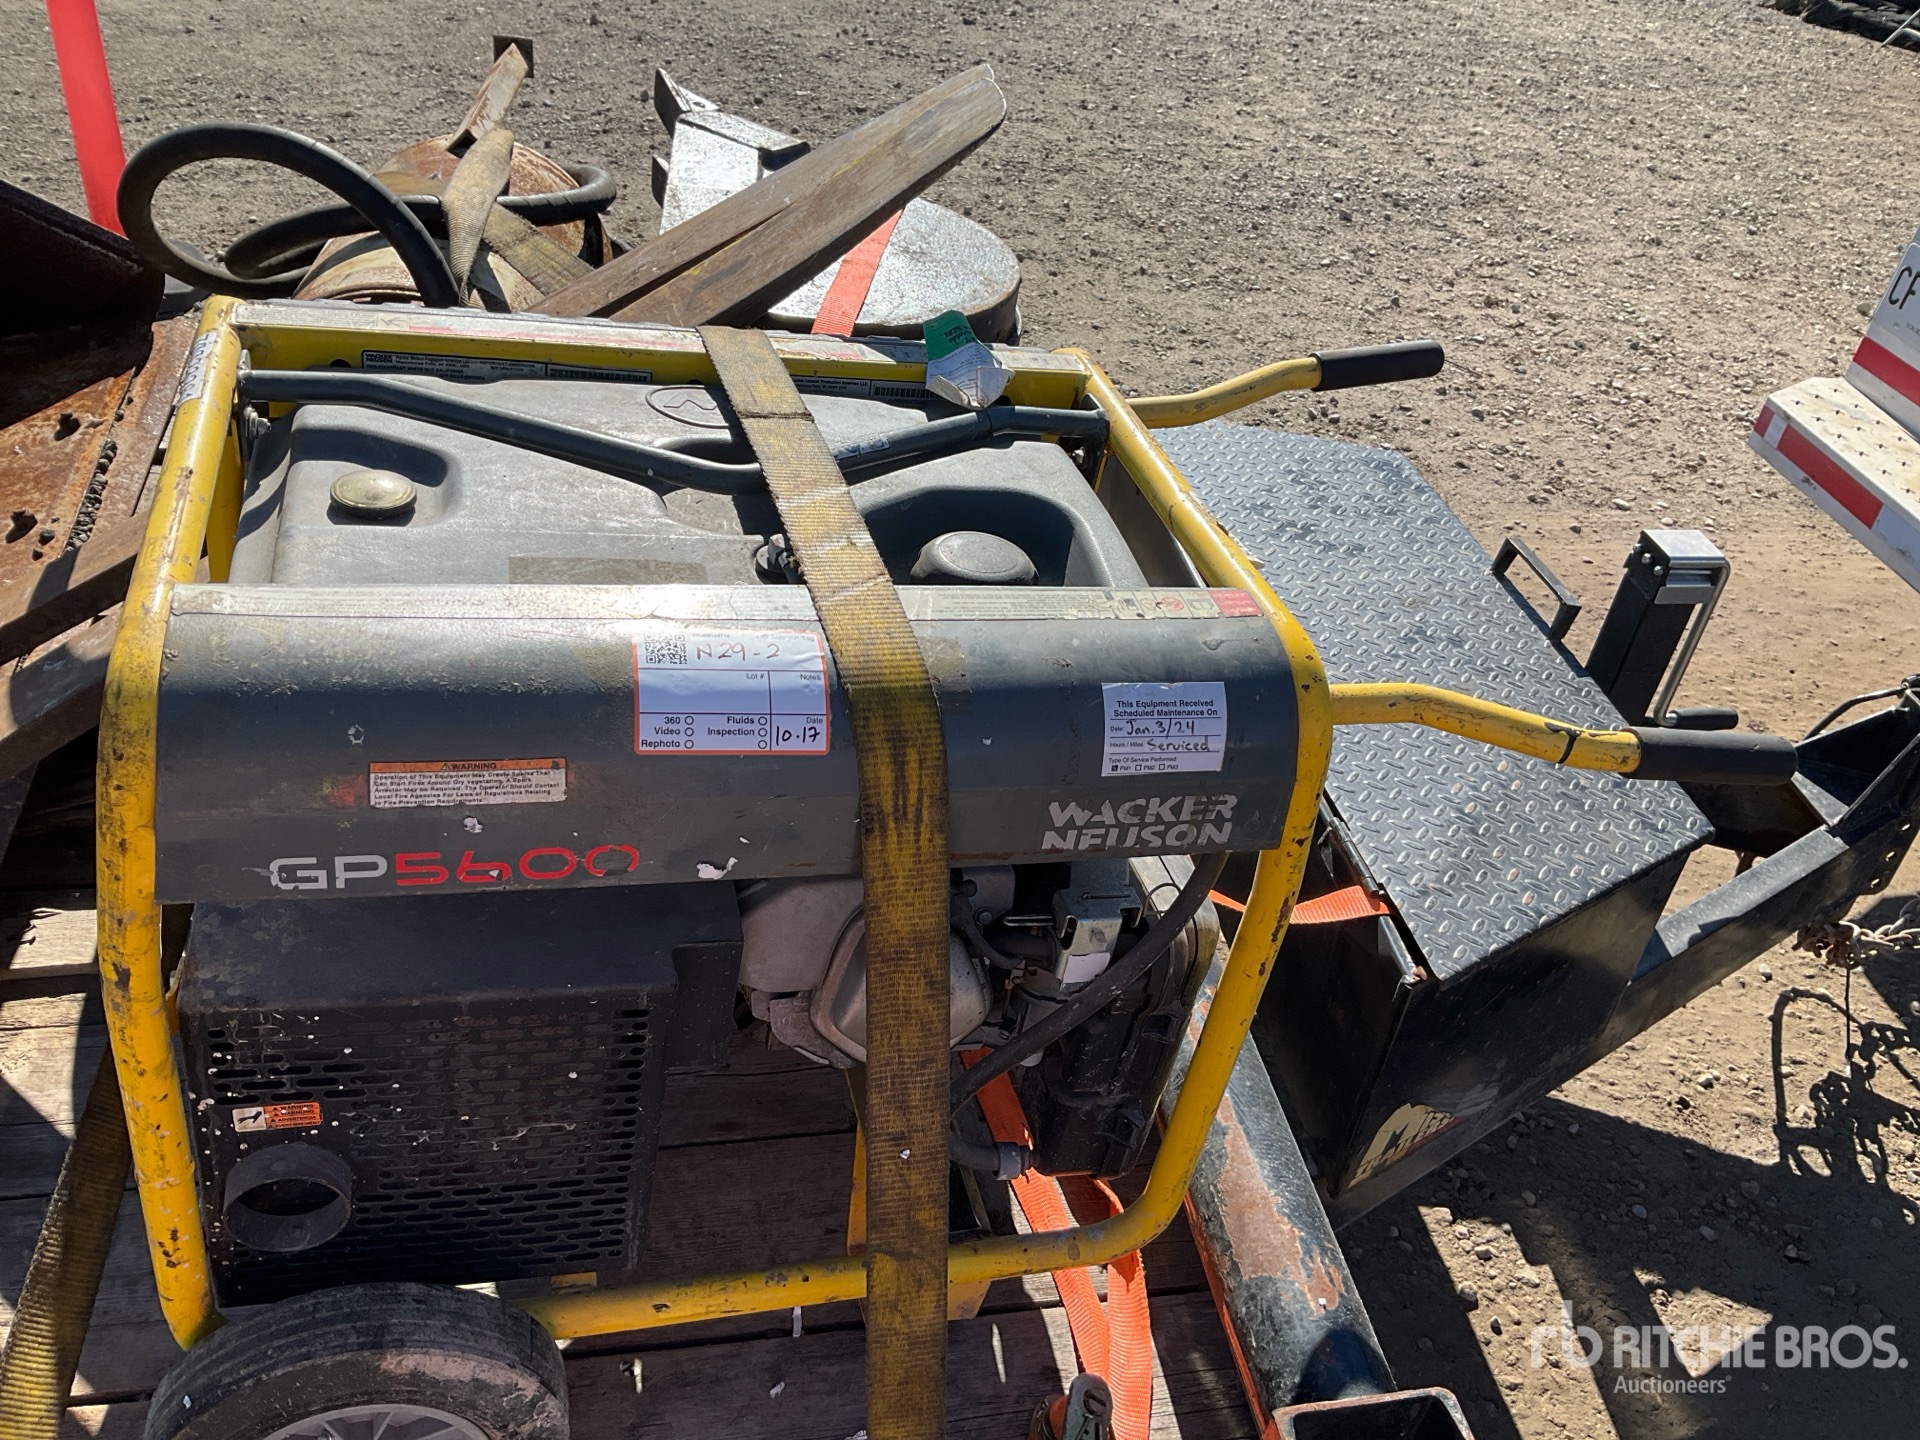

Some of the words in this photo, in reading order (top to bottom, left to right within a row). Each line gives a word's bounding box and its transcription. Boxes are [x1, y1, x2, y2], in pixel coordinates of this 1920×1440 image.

[1116, 700, 1134, 708] This
[1136, 700, 1176, 709] Equipment
[1180, 700, 1214, 708] Received
[1156, 708, 1204, 716] Maintenance
[1207, 708, 1218, 716] On
[727, 716, 754, 724] Fluids
[708, 728, 754, 738] Inspection
[1126, 718, 1154, 736] Jan.
[1156, 718, 1195, 740] 3/24
[641, 740, 680, 750] Rephoto
[1147, 736, 1210, 752] Serviced
[452, 762, 496, 770] WARNING
[1048, 794, 1238, 827] WACKER
[269, 844, 640, 890] GP5600
